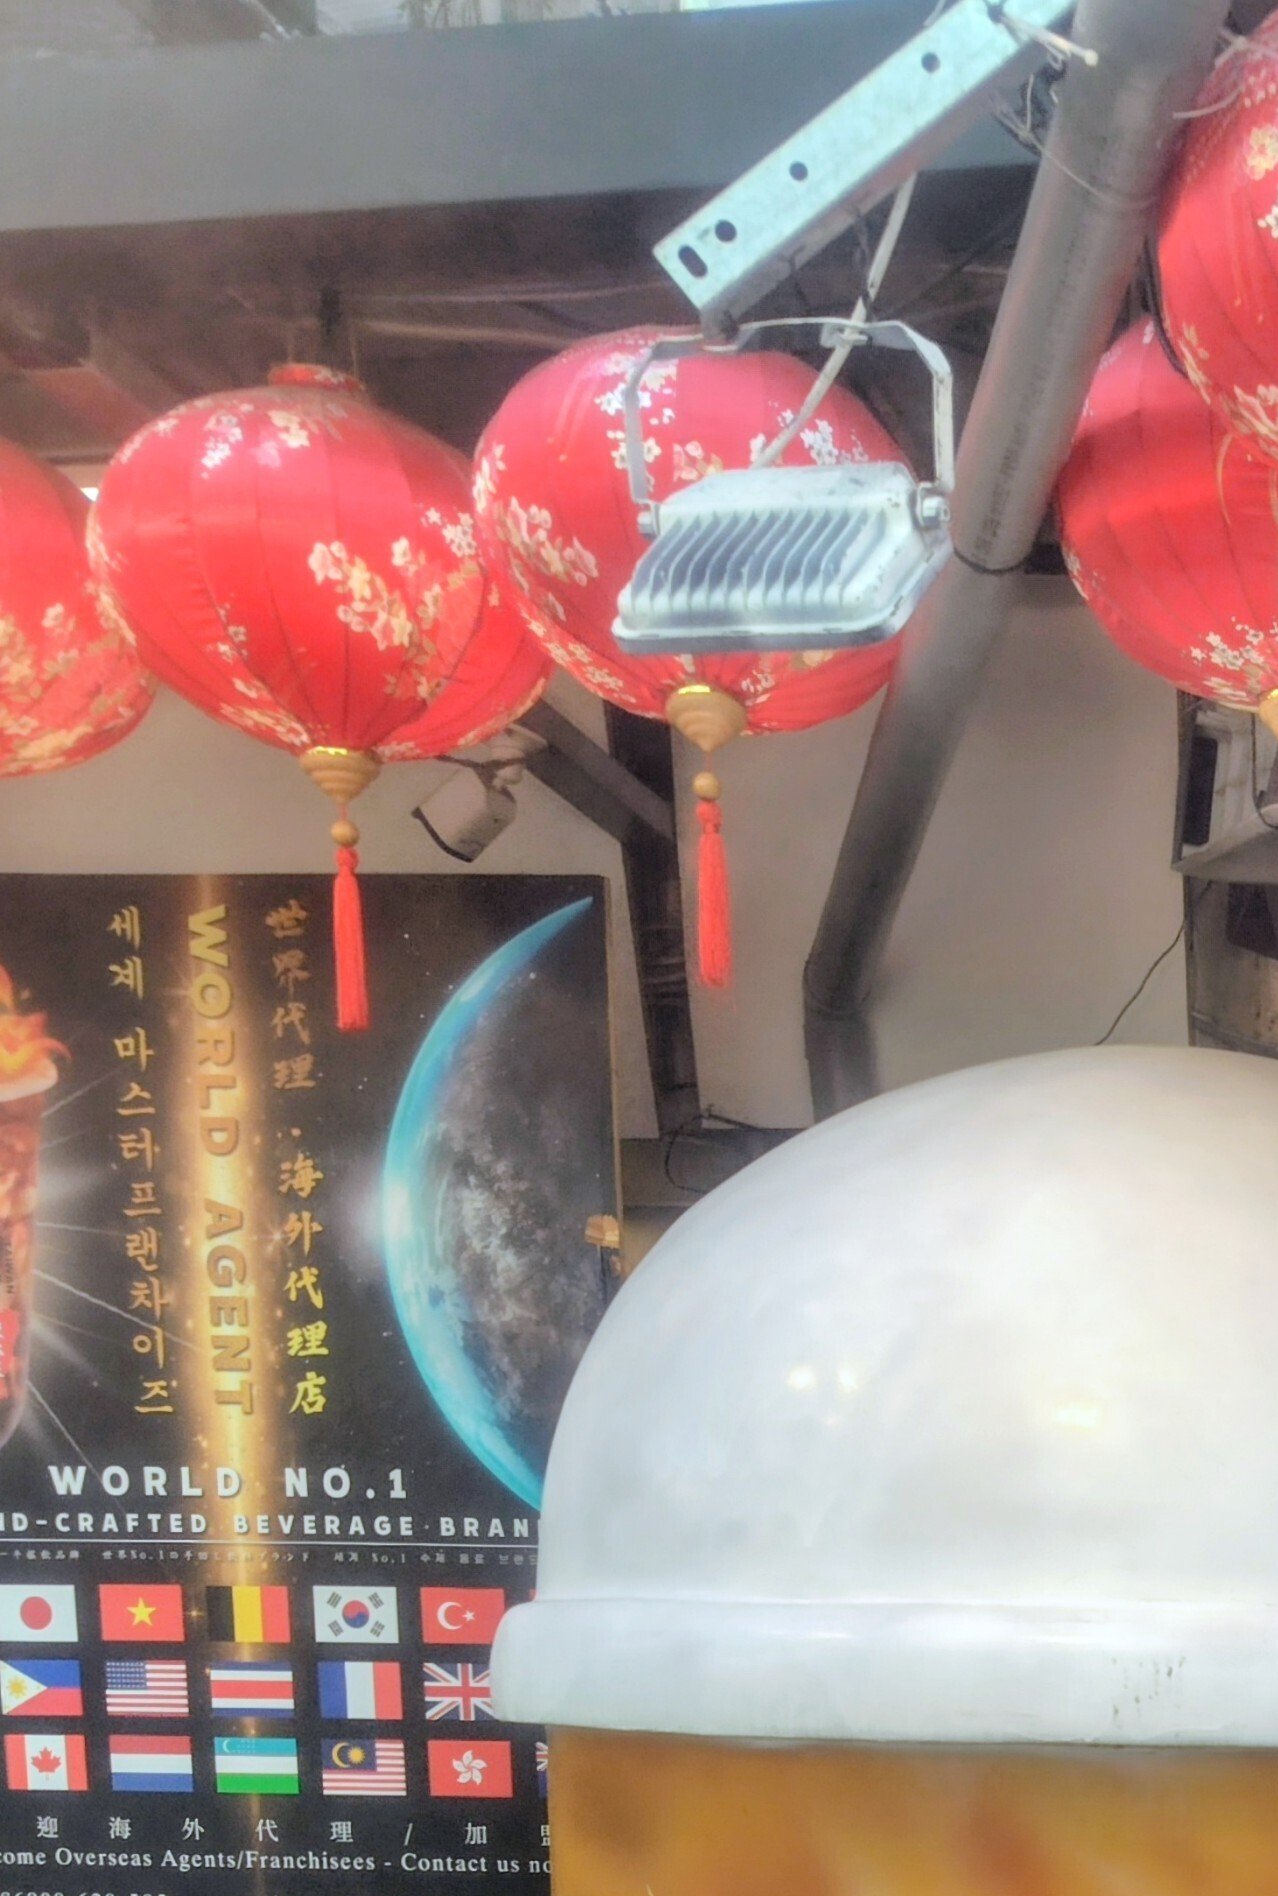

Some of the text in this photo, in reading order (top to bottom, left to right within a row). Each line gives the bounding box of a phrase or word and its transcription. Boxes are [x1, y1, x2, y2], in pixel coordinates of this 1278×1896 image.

[107, 905, 174, 1413] 세계 마스터프랜차이즈
[188, 903, 254, 1416] WORLD AGENT
[48, 1465, 406, 1499] WORLD NO.1
[234, 1514, 413, 1536] BEVERAGE
[55, 1847, 152, 1867] Overseas
[161, 1850, 375, 1872] Agents/Franchisees
[400, 1852, 488, 1873] Contact
[497, 1859, 520, 1873] us
